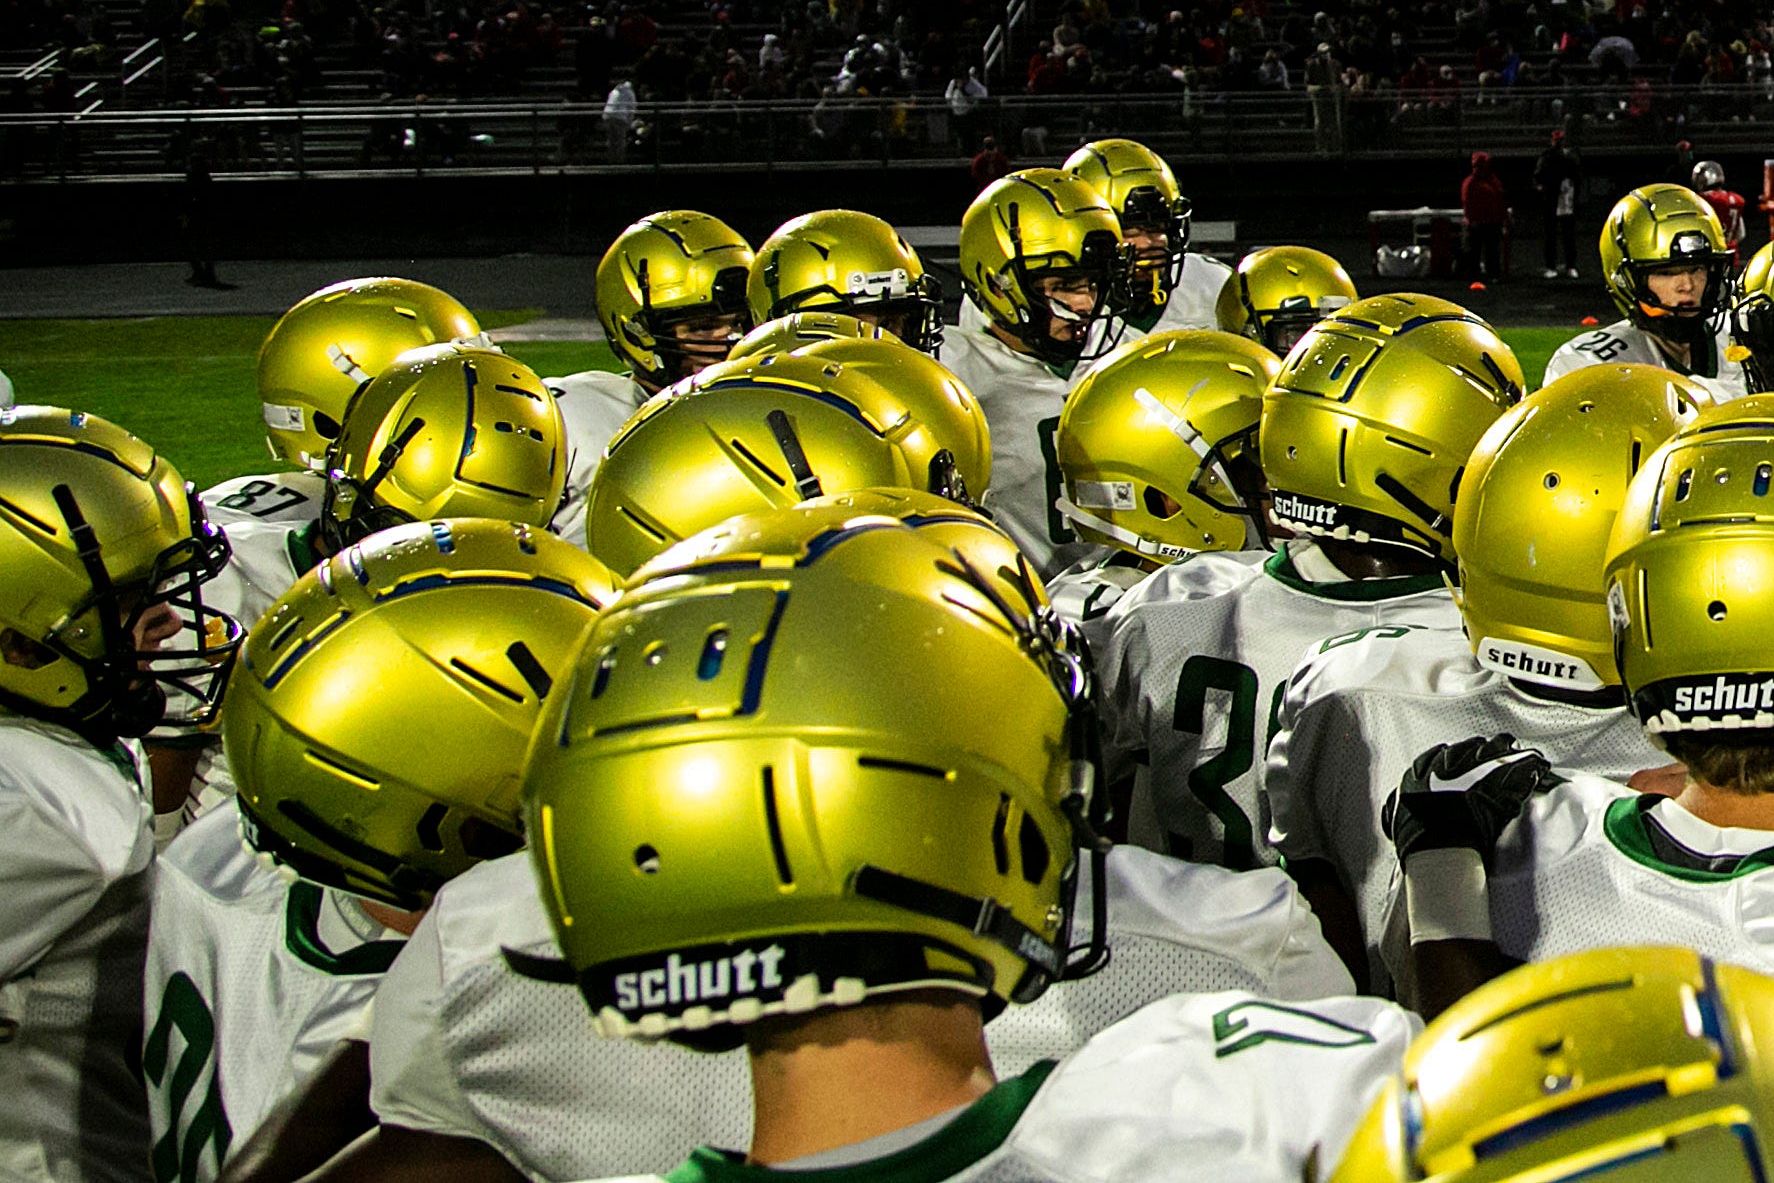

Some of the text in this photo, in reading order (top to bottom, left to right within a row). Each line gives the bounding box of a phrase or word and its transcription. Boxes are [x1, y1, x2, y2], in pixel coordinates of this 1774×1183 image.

[1575, 331, 1629, 361] 26
[216, 480, 310, 517] 87
[1274, 495, 1337, 525] schutt
[1487, 648, 1577, 679] schutt
[615, 943, 785, 1010] schutt
